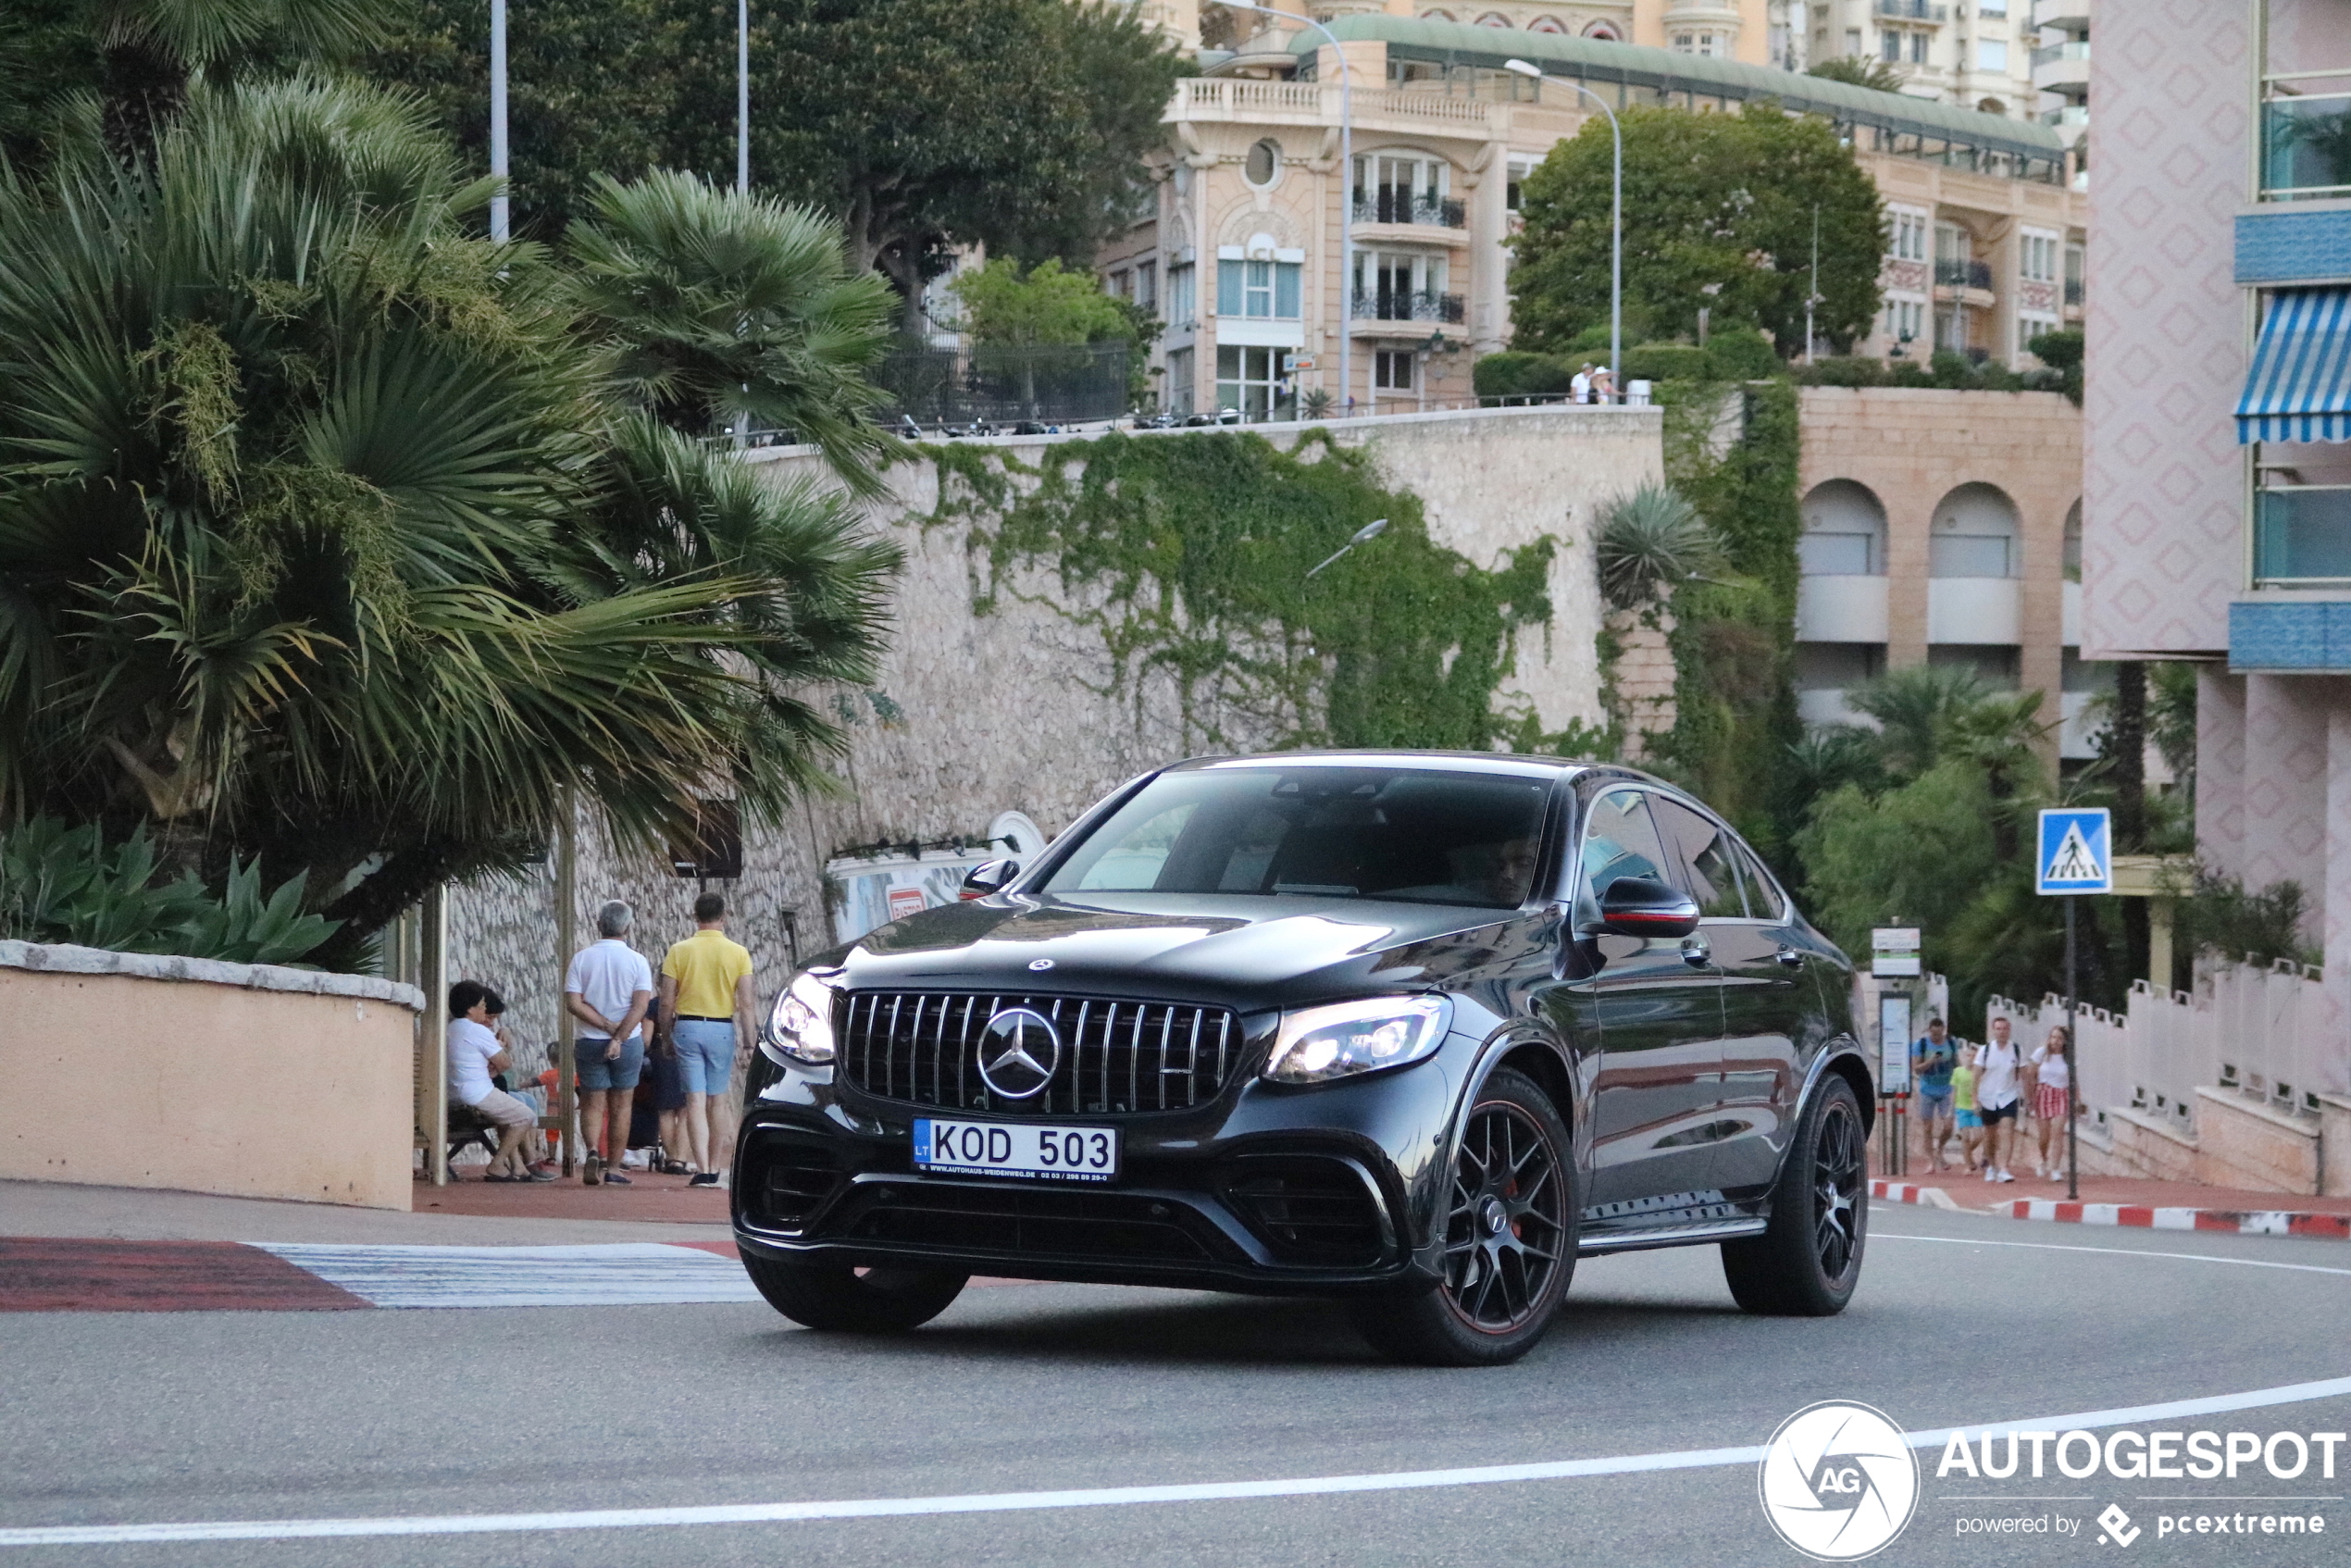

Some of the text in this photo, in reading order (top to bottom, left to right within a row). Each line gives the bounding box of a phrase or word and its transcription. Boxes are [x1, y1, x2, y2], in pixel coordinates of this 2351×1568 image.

[915, 1146, 928, 1155] LT
[935, 1125, 1109, 1168] KOD 503
[930, 1164, 1035, 1178] WWW.AUTOHAUS-WEIDENWEG.DE
